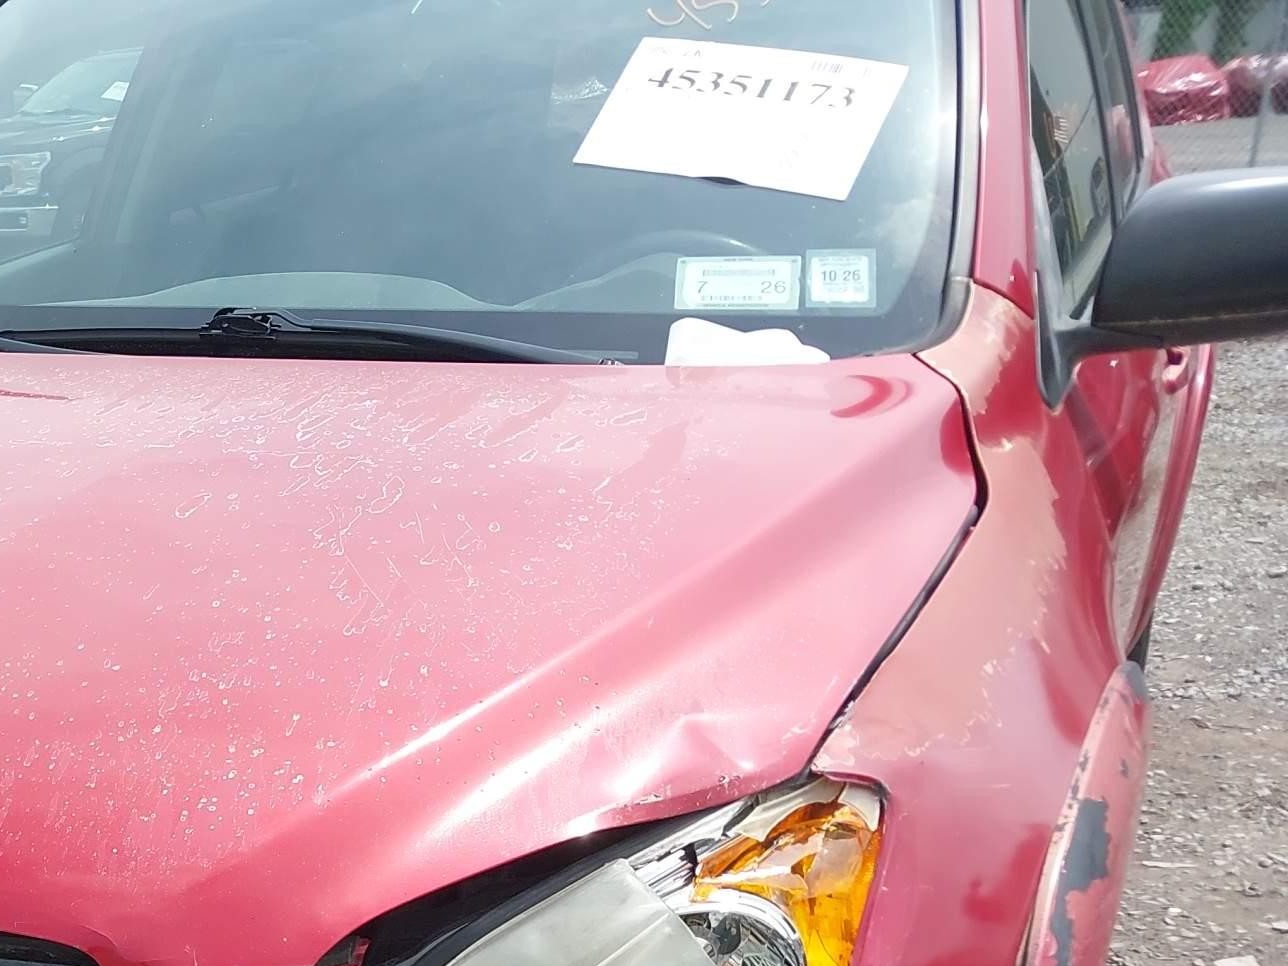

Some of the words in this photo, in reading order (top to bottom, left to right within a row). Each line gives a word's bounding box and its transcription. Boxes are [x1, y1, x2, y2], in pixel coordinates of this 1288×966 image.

[647, 67, 856, 108] 45351173
[821, 270, 837, 282] 10
[842, 269, 861, 282] 26
[696, 280, 709, 295] 7
[760, 280, 787, 295] 26
